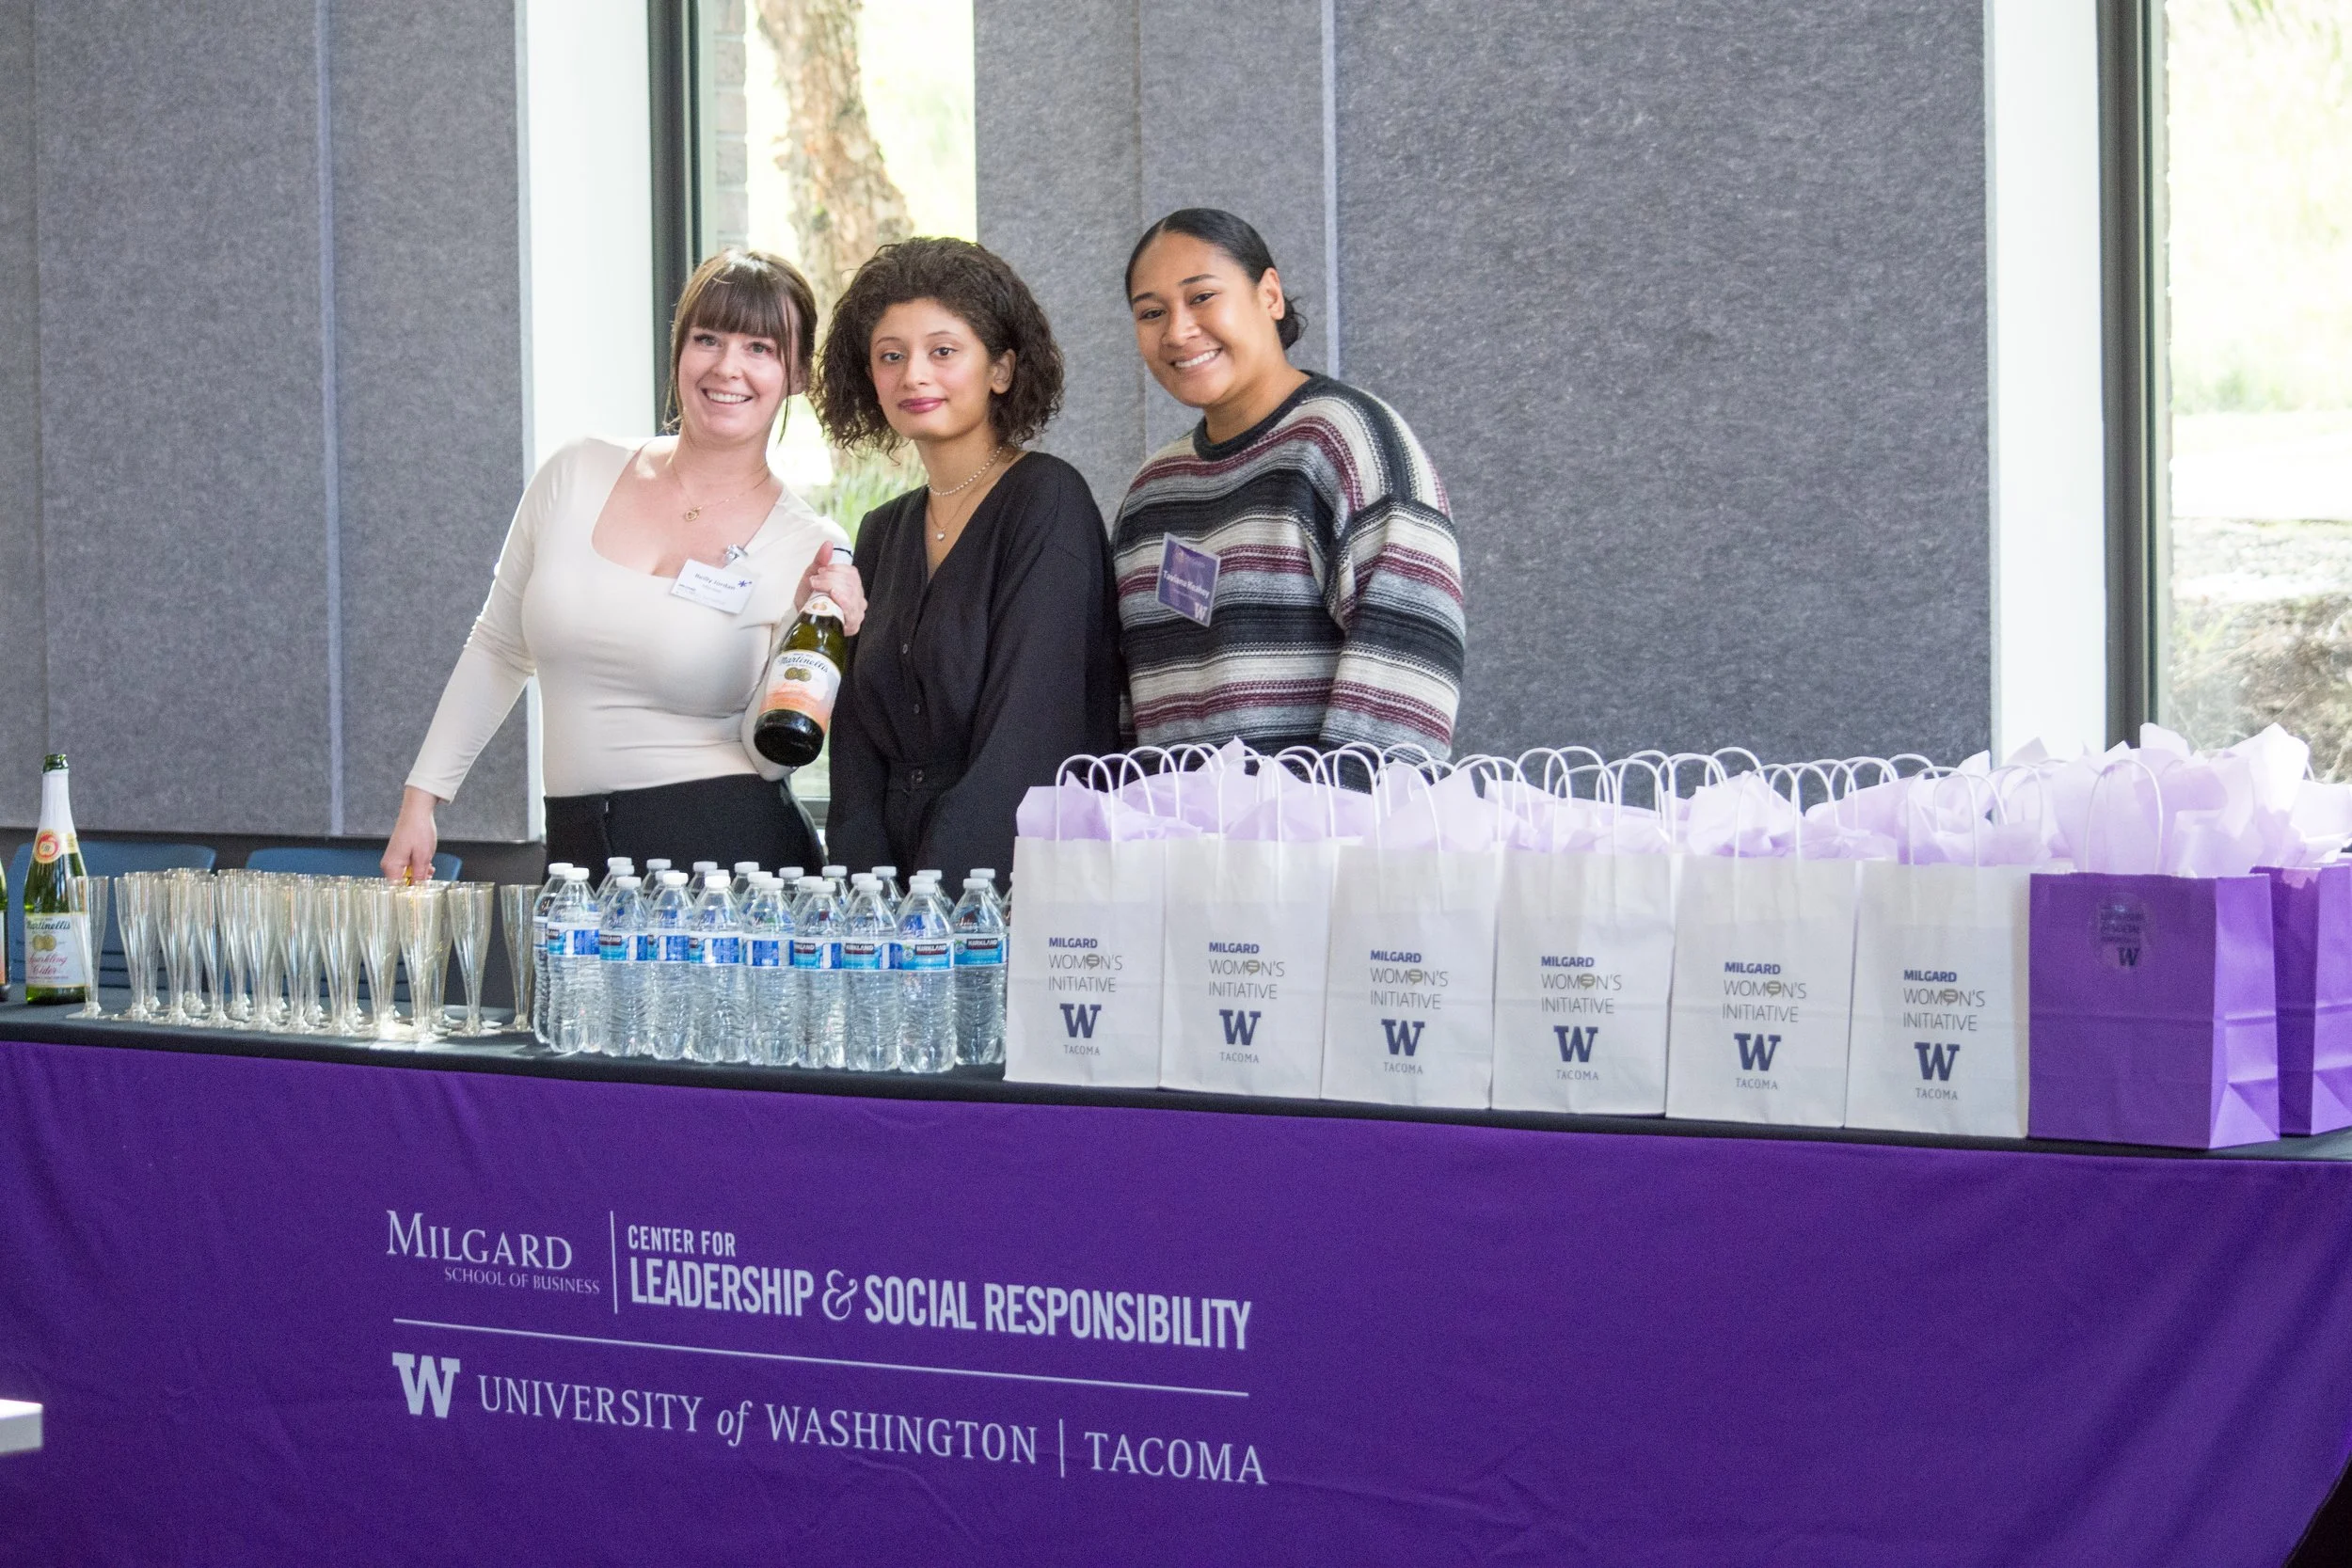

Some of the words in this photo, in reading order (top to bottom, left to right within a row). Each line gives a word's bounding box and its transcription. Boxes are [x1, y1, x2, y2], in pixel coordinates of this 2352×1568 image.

[916, 943, 947, 952] KIRKLAND
[1048, 938, 1098, 948] MILGARD
[1209, 942, 1260, 954] MILGARD
[1370, 950, 1422, 963] MILGARD
[1541, 956, 1595, 968] MILGARD
[1724, 961, 1781, 974] MILGARD
[1903, 969, 1957, 983] MILGARD
[1048, 975, 1117, 993] INITIATIVE
[1208, 981, 1278, 999] INITIATIVE
[1370, 990, 1441, 1010] INITIATIVE
[1541, 996, 1614, 1014] INITIATIVE
[1059, 1003, 1102, 1038] W
[1722, 1004, 1799, 1022] INITIATIVE
[1903, 1012, 1978, 1031] INITIATIVE
[1218, 1009, 1262, 1045] W
[1381, 1019, 1425, 1056] W
[1553, 1025, 1598, 1063] W
[1063, 1044, 1101, 1055] TACOMA
[1219, 1052, 1259, 1063] TACOMA
[1734, 1033, 1781, 1071] W
[1383, 1062, 1423, 1074] TACOMA
[1914, 1041, 1960, 1082] W
[1556, 1069, 1599, 1081] TACOMA
[1735, 1077, 1778, 1090] TACOMA
[1915, 1087, 1958, 1101] TACOMA
[386, 1210, 573, 1270] MILGARD
[628, 1225, 694, 1255] CENTER
[701, 1230, 736, 1257] FOR
[443, 1266, 506, 1287] SCHOOL
[509, 1273, 530, 1289] OF
[532, 1275, 600, 1295] BUSINESS
[630, 1257, 815, 1317] LEADERSHIP
[822, 1269, 858, 1320] &
[865, 1274, 977, 1330] SOCIAL
[984, 1282, 1251, 1350] RESPONSIBILITY
[391, 1351, 460, 1418] W
[477, 1374, 704, 1433] UNIVERSITY
[717, 1401, 753, 1447] of
[765, 1402, 1038, 1465] WASHINGTON
[1084, 1431, 1269, 1485] TACOMA
